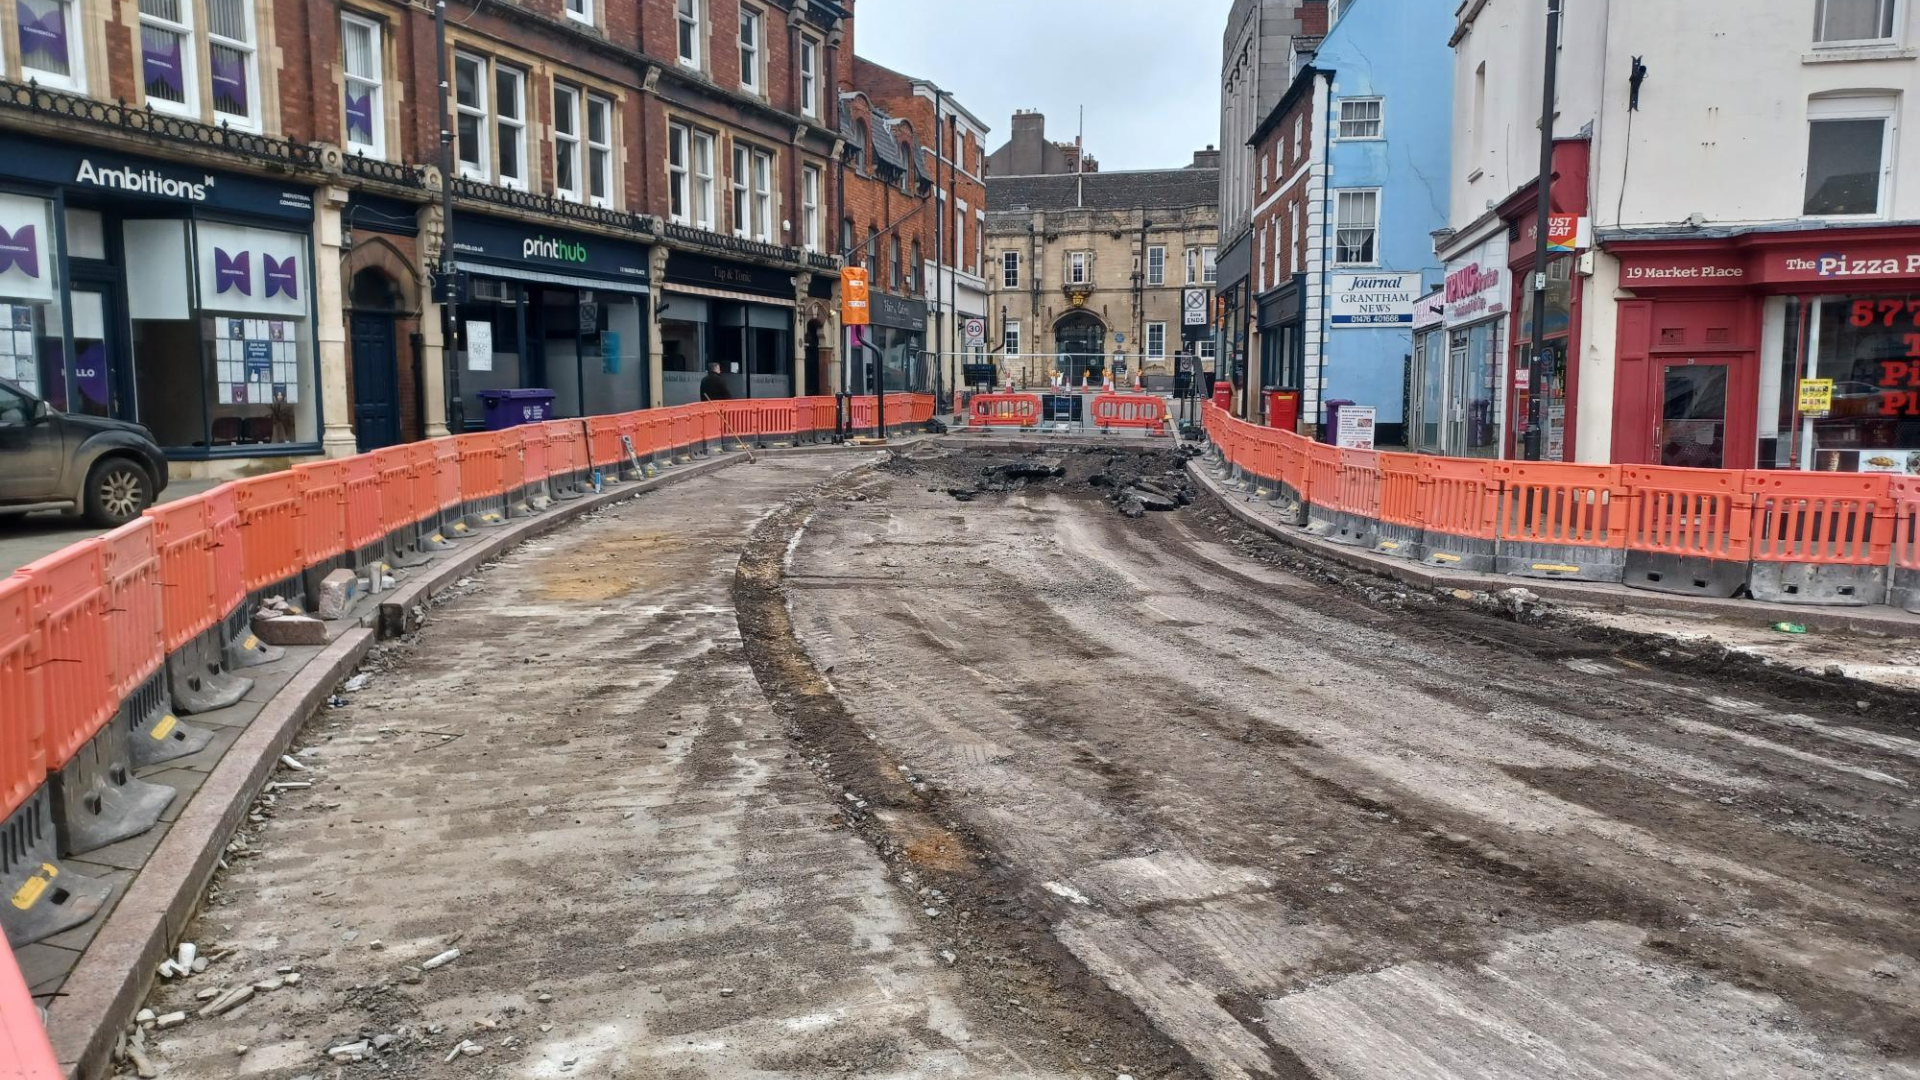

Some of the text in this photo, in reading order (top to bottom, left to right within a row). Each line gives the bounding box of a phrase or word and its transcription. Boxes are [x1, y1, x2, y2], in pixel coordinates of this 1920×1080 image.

[76, 158, 207, 201] Ambitions
[1548, 226, 1571, 237] EAT
[523, 234, 587, 263] printhub
[1786, 259, 1816, 270] The
[1818, 254, 1900, 276] Pizza
[1626, 266, 1743, 279] 19 Market Place
[1348, 276, 1402, 291] Journal
[1341, 293, 1409, 303] GRANTHAM
[1359, 304, 1391, 313] NEWS
[1351, 315, 1371, 323] 01476
[968, 325, 981, 333] 30
